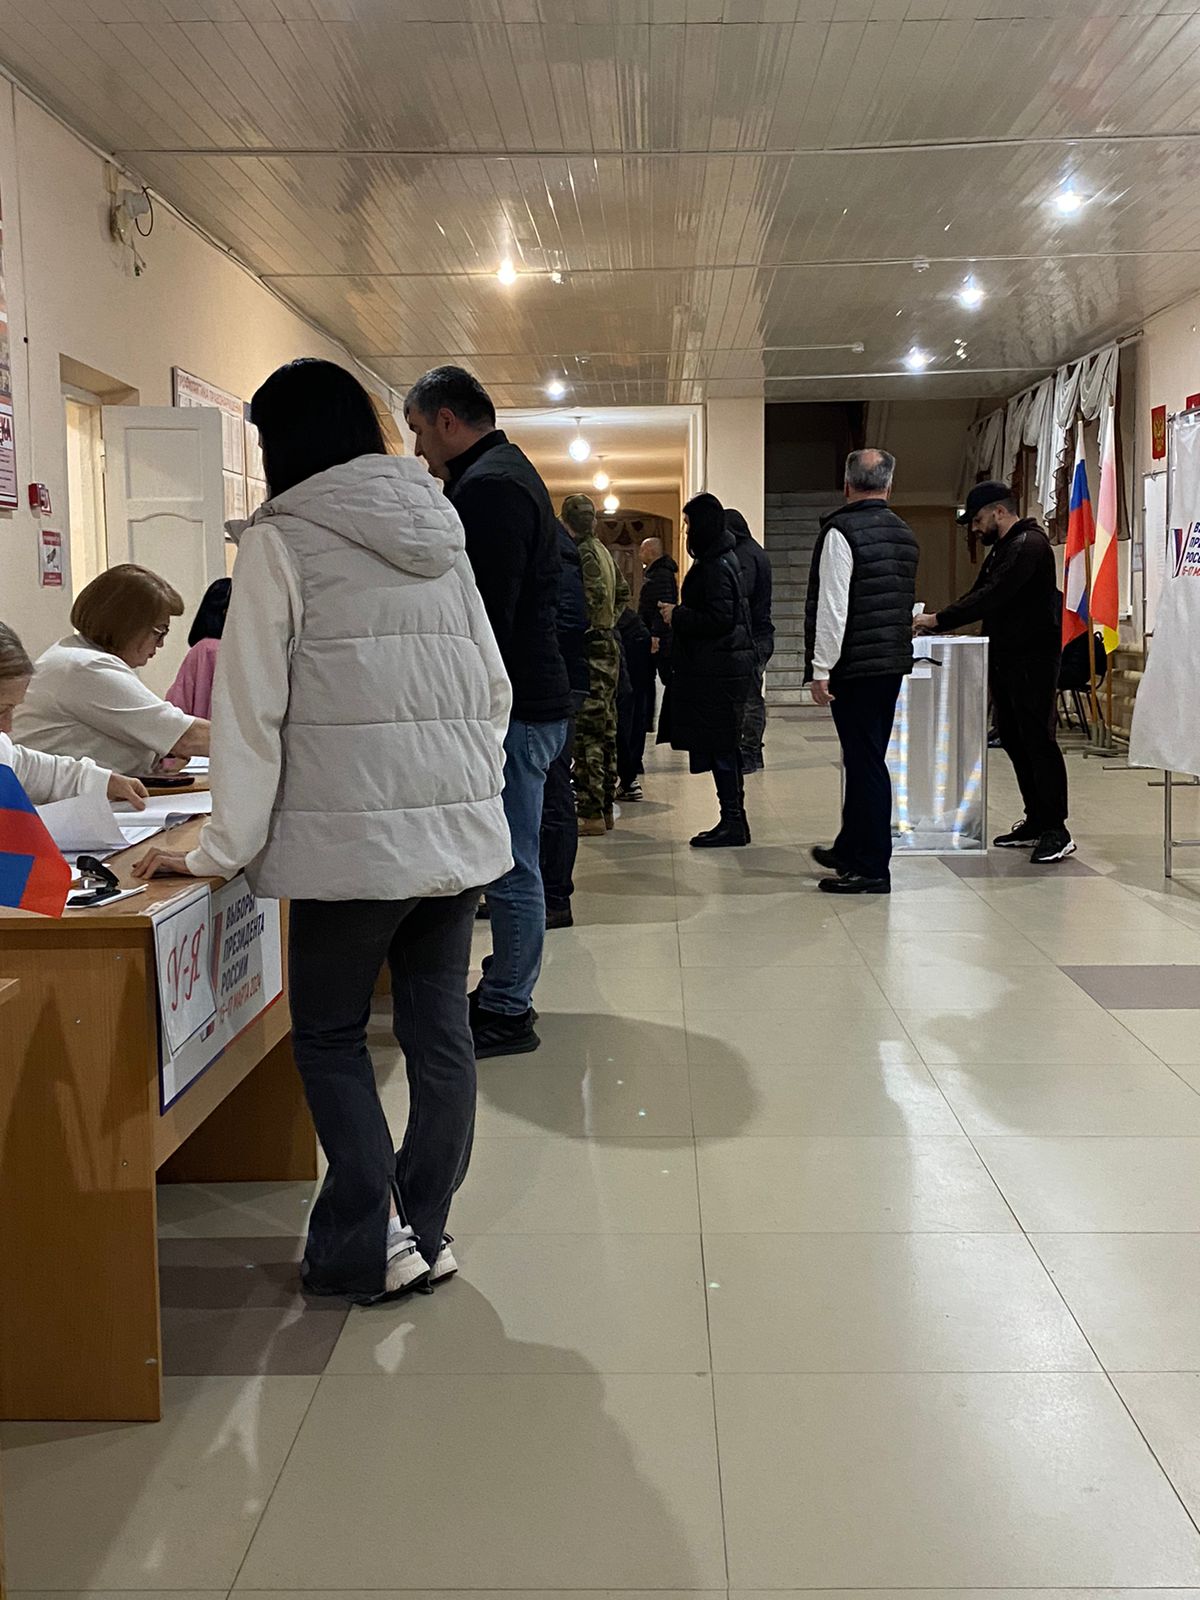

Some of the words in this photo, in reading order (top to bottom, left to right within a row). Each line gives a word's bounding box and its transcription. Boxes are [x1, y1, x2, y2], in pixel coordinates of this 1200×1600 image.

[226, 893, 256, 931] ВЫБОРЫ
[223, 911, 265, 963] ПРЕЗИДЕНТА
[167, 922, 205, 1012] У-Я
[221, 953, 249, 996] РОССИИ
